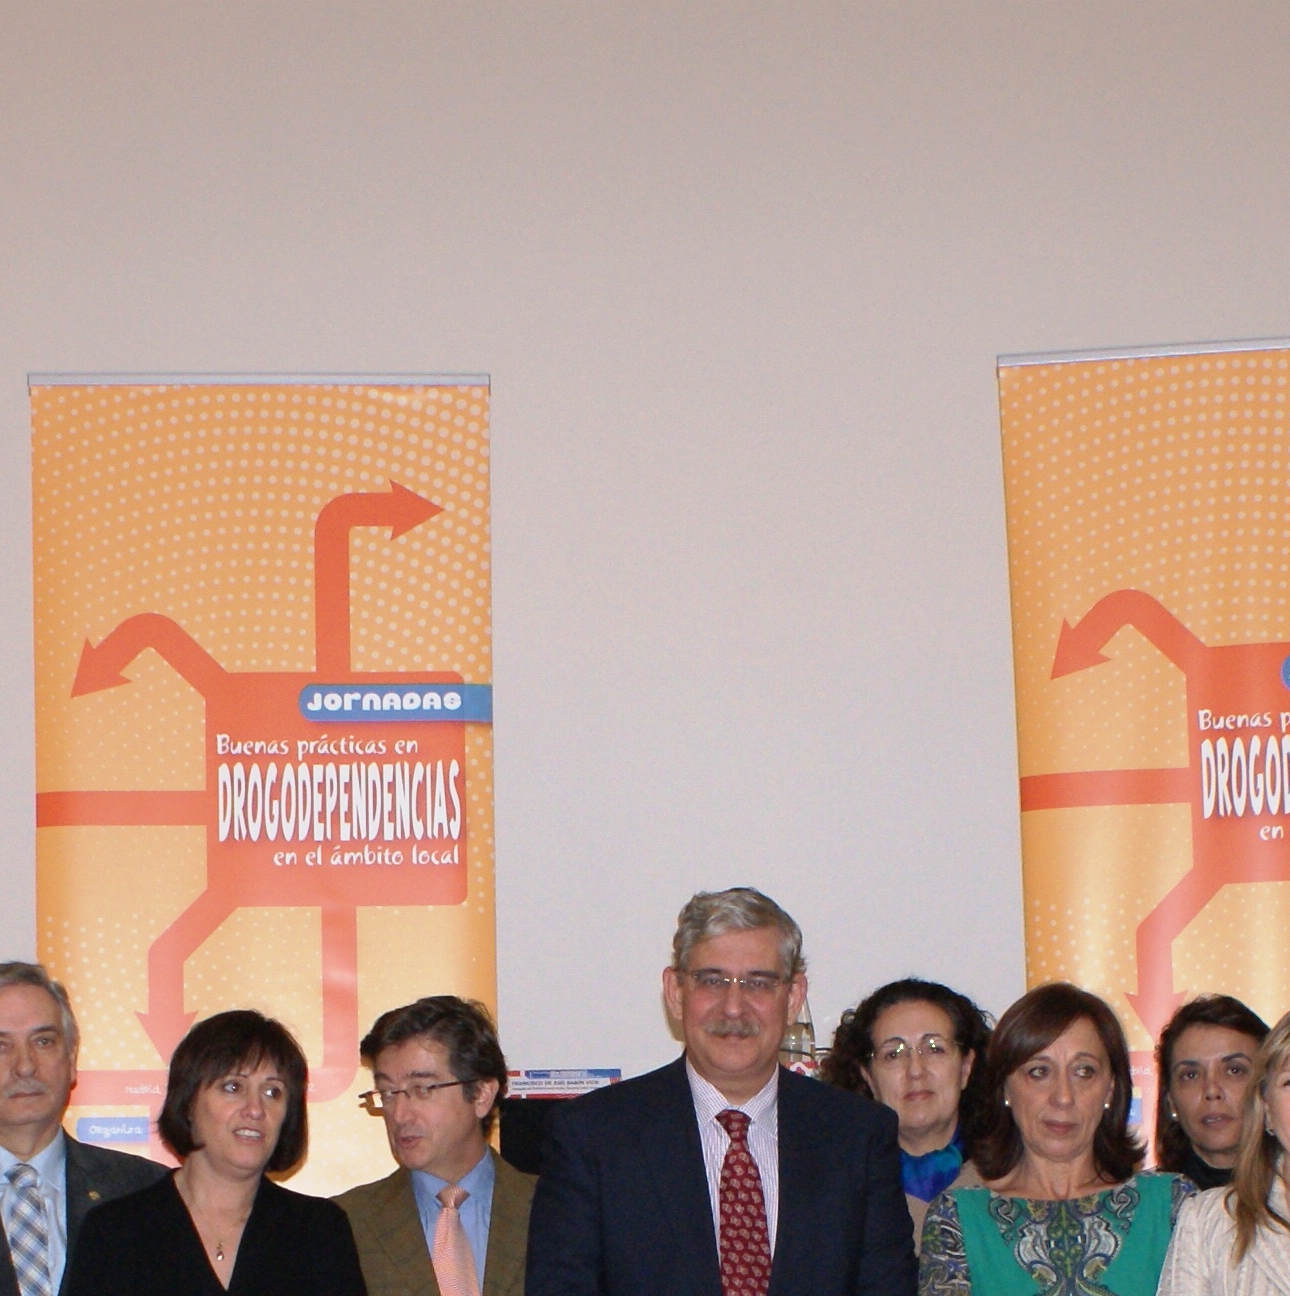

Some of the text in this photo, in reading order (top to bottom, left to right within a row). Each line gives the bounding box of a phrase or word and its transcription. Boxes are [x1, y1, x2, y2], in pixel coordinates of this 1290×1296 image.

[1198, 709, 1272, 730] Buenas
[216, 733, 418, 761] Buenas prácticas en
[218, 759, 461, 842] DROGODEPENDENCIAS
[1259, 825, 1284, 840] en
[273, 844, 459, 866] en el ámbito local
[89, 1124, 143, 1138] Organiza
